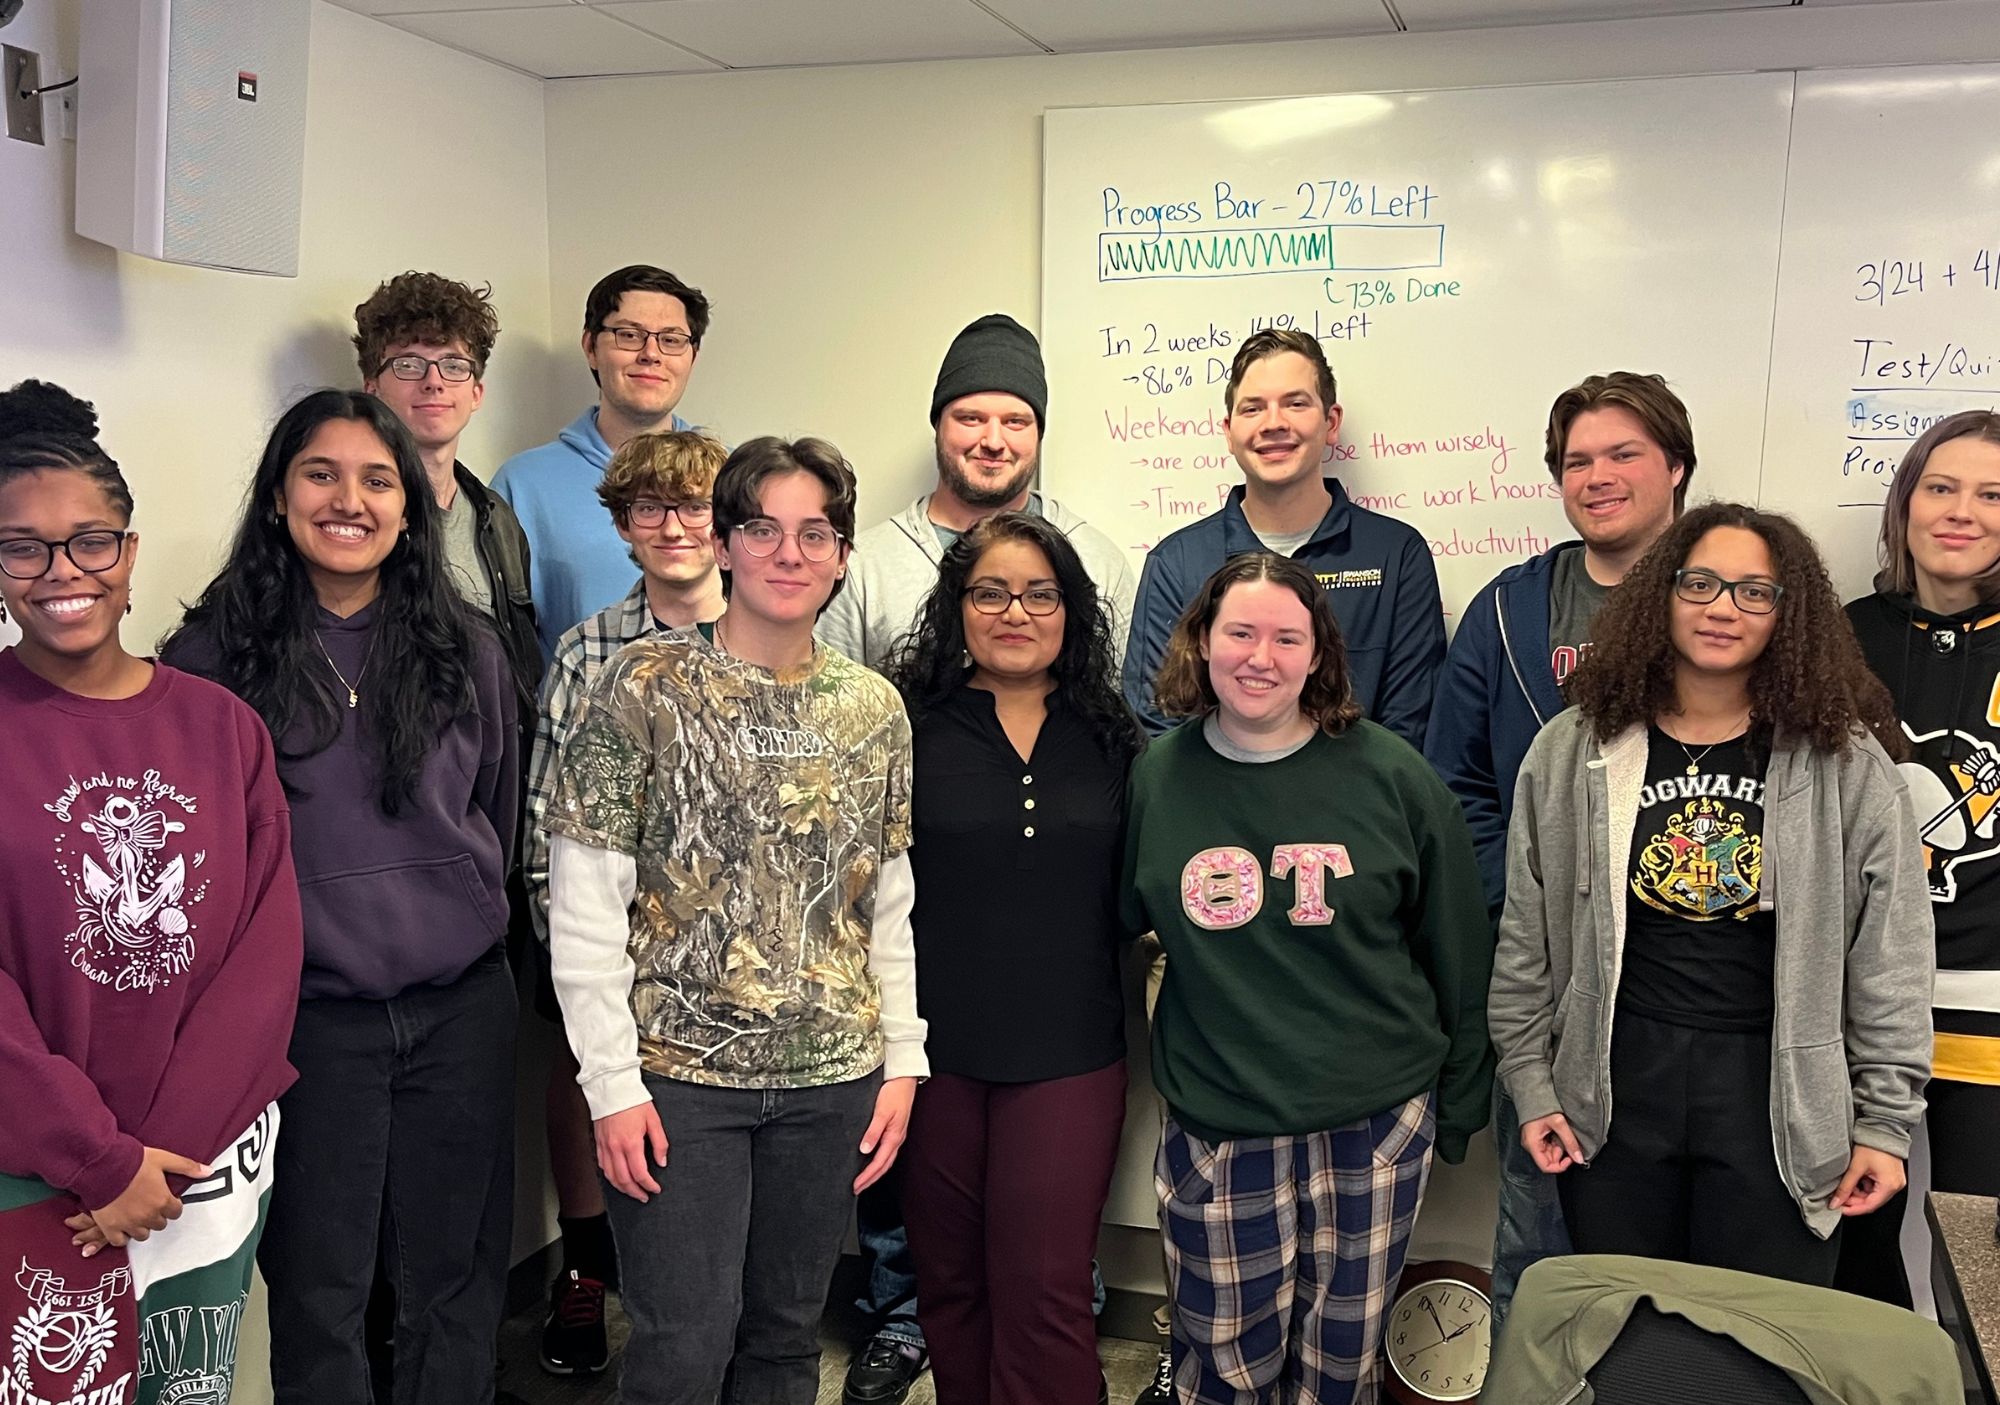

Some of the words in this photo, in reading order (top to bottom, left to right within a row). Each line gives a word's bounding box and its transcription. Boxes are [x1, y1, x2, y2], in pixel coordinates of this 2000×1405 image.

[1103, 187, 1202, 246] Progress
[1215, 181, 1266, 220] Bar
[1297, 181, 1363, 220] 27%
[1371, 185, 1439, 220] Left
[1346, 280, 1396, 310] 73%
[1407, 278, 1461, 303] Done
[1856, 260, 1924, 307] 3/24
[1943, 264, 1958, 287] +
[1099, 326, 1132, 358] In
[1143, 323, 1160, 354] 2
[1315, 310, 1373, 341] Left
[1143, 366, 1194, 396] 86%
[1207, 358, 1233, 385] Do
[1854, 339, 2000, 386] Test/Qui
[1105, 405, 1226, 442] Weekends
[1152, 456, 1183, 470] are
[1193, 455, 1231, 470] our
[1369, 432, 1427, 460] them
[1435, 426, 1517, 474] wisely
[1843, 445, 1896, 487] Proj
[1152, 486, 1208, 518] Time
[1346, 486, 1412, 509] emic
[1424, 480, 1487, 508] work
[1490, 475, 1562, 501] hours
[82, 771, 114, 791] and
[117, 776, 139, 791] no
[142, 768, 198, 814] Regrets
[1638, 774, 1765, 809] OGWAR
[1696, 871, 1711, 887] H
[71, 947, 113, 985] Ocean
[165, 935, 195, 975] MD
[1402, 1309, 1412, 1322] 9
[1438, 1291, 1451, 1306] 11
[1458, 1297, 1474, 1313] 12
[1478, 1313, 1486, 1326] 1
[1396, 1331, 1407, 1345] 8
[1406, 1353, 1417, 1367] 7
[1420, 1369, 1431, 1382] 6
[1440, 1376, 1453, 1389] 5
[1463, 1373, 1474, 1385] 4
